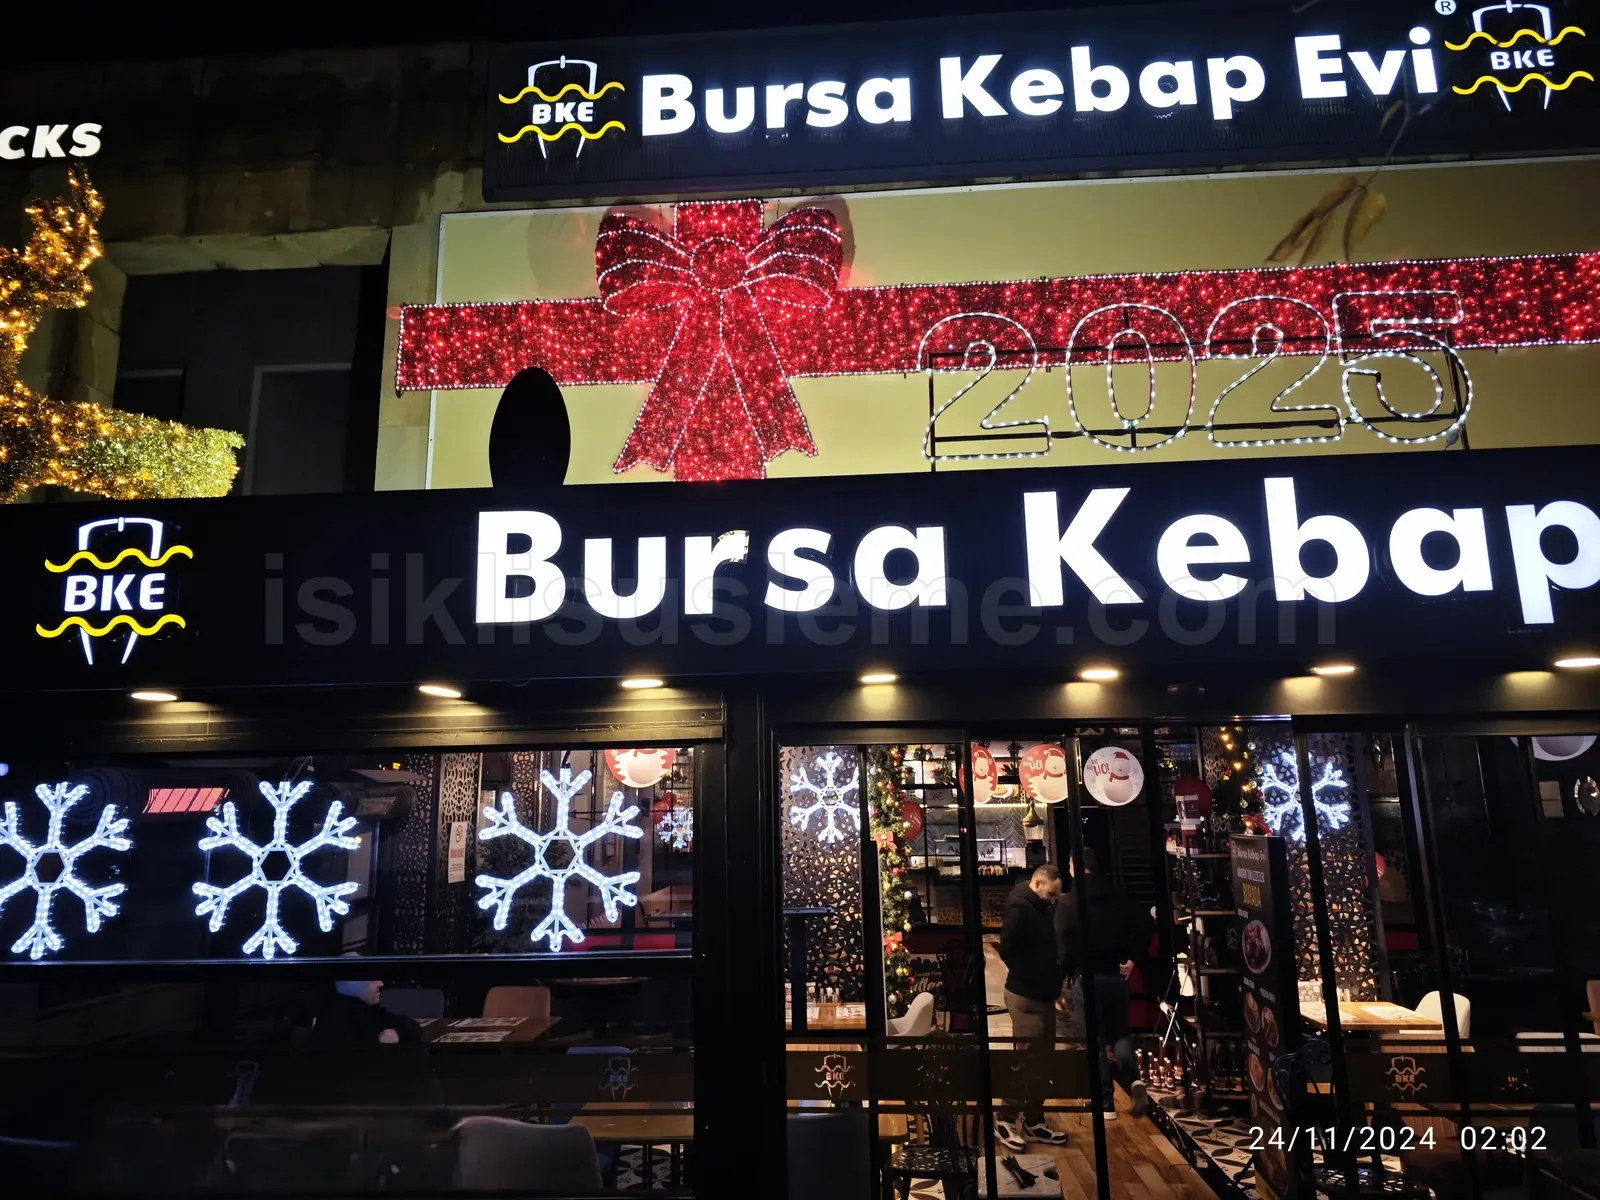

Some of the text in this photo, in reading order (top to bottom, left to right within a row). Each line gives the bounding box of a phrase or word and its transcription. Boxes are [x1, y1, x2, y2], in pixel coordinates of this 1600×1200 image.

[642, 74, 912, 138] Bursa
[940, 46, 1266, 120] Kebap
[1295, 27, 1438, 99] Evi
[1490, 49, 1555, 70] BKE
[532, 101, 594, 124] BKE
[917, 289, 1474, 463] 2025
[475, 477, 1600, 625] Bursa Kebap
[64, 573, 166, 612] BKE
